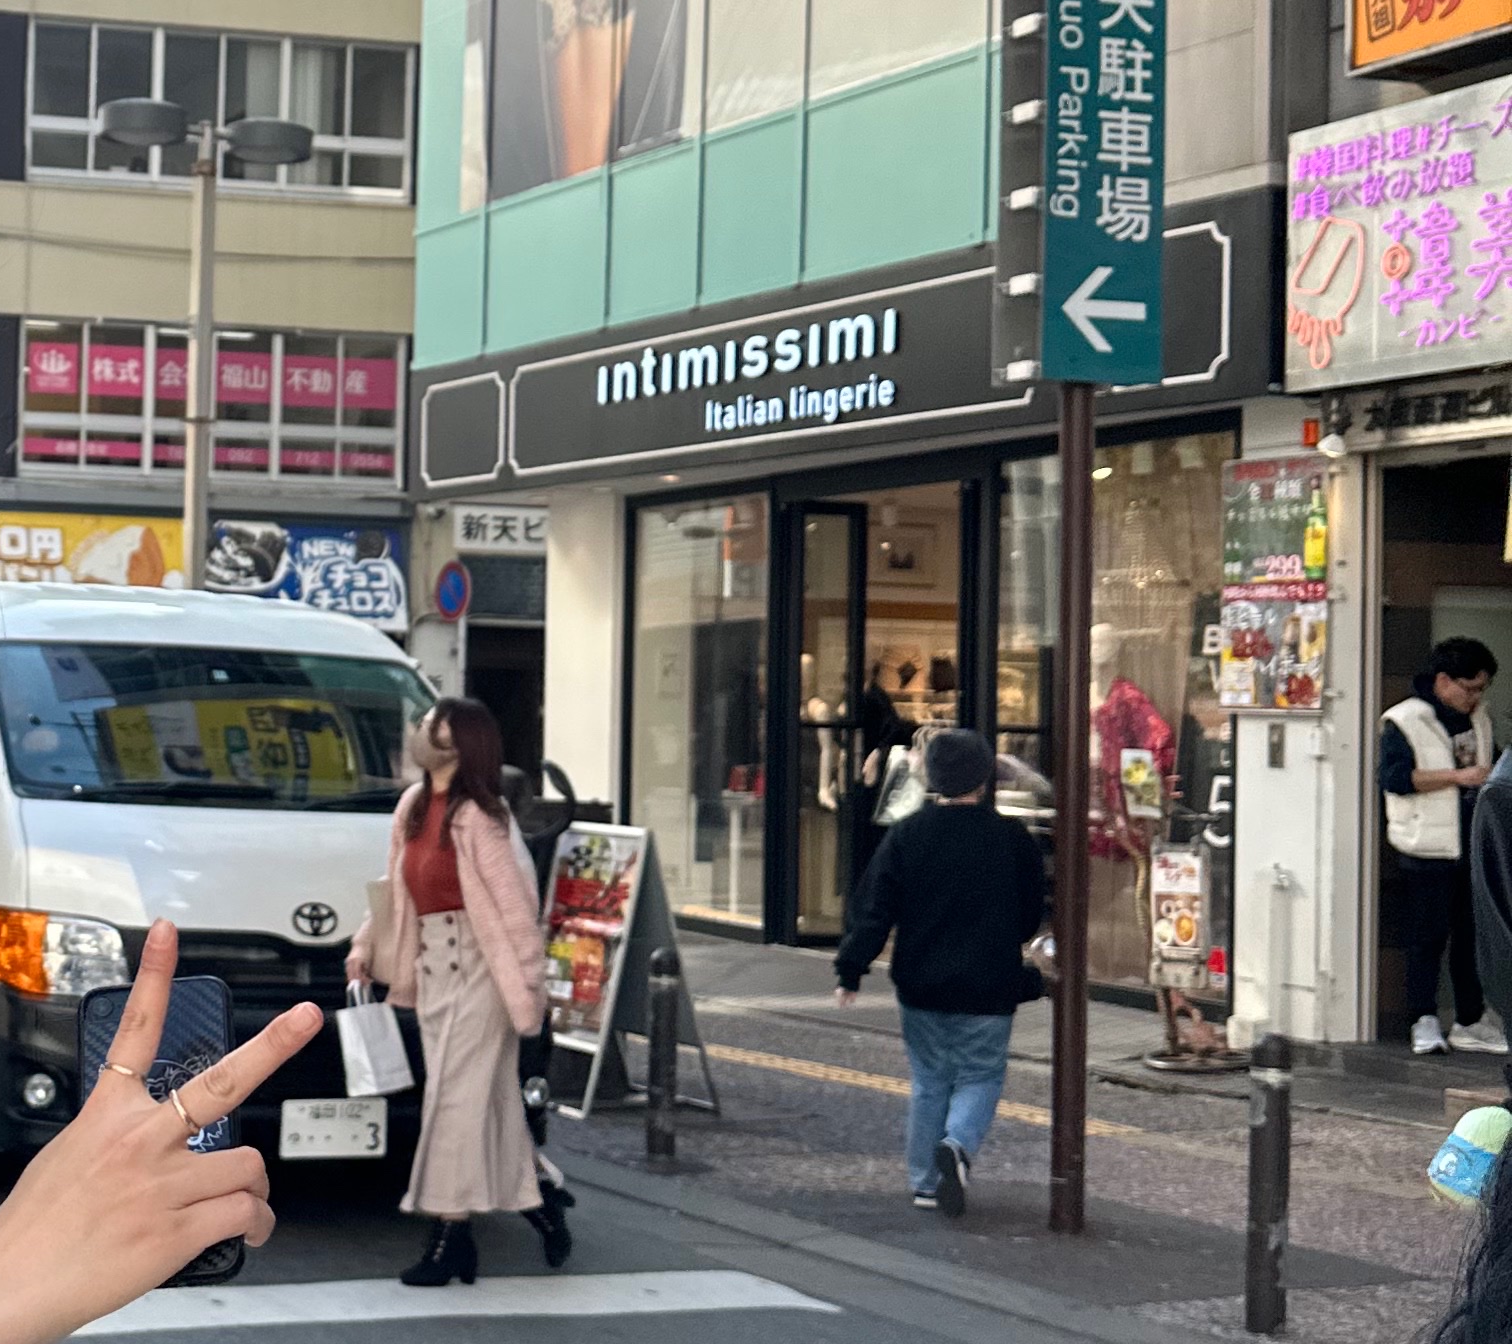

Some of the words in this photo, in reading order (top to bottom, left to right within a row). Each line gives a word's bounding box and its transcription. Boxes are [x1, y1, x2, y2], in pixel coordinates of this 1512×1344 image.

[1049, 65, 1090, 219] Parking
[597, 307, 898, 406] intimissimi
[704, 393, 785, 433] Italian
[788, 373, 896, 424] lingerie
[301, 539, 356, 559] NEW
[326, 563, 389, 590] チョコ
[311, 590, 395, 612] チュロス
